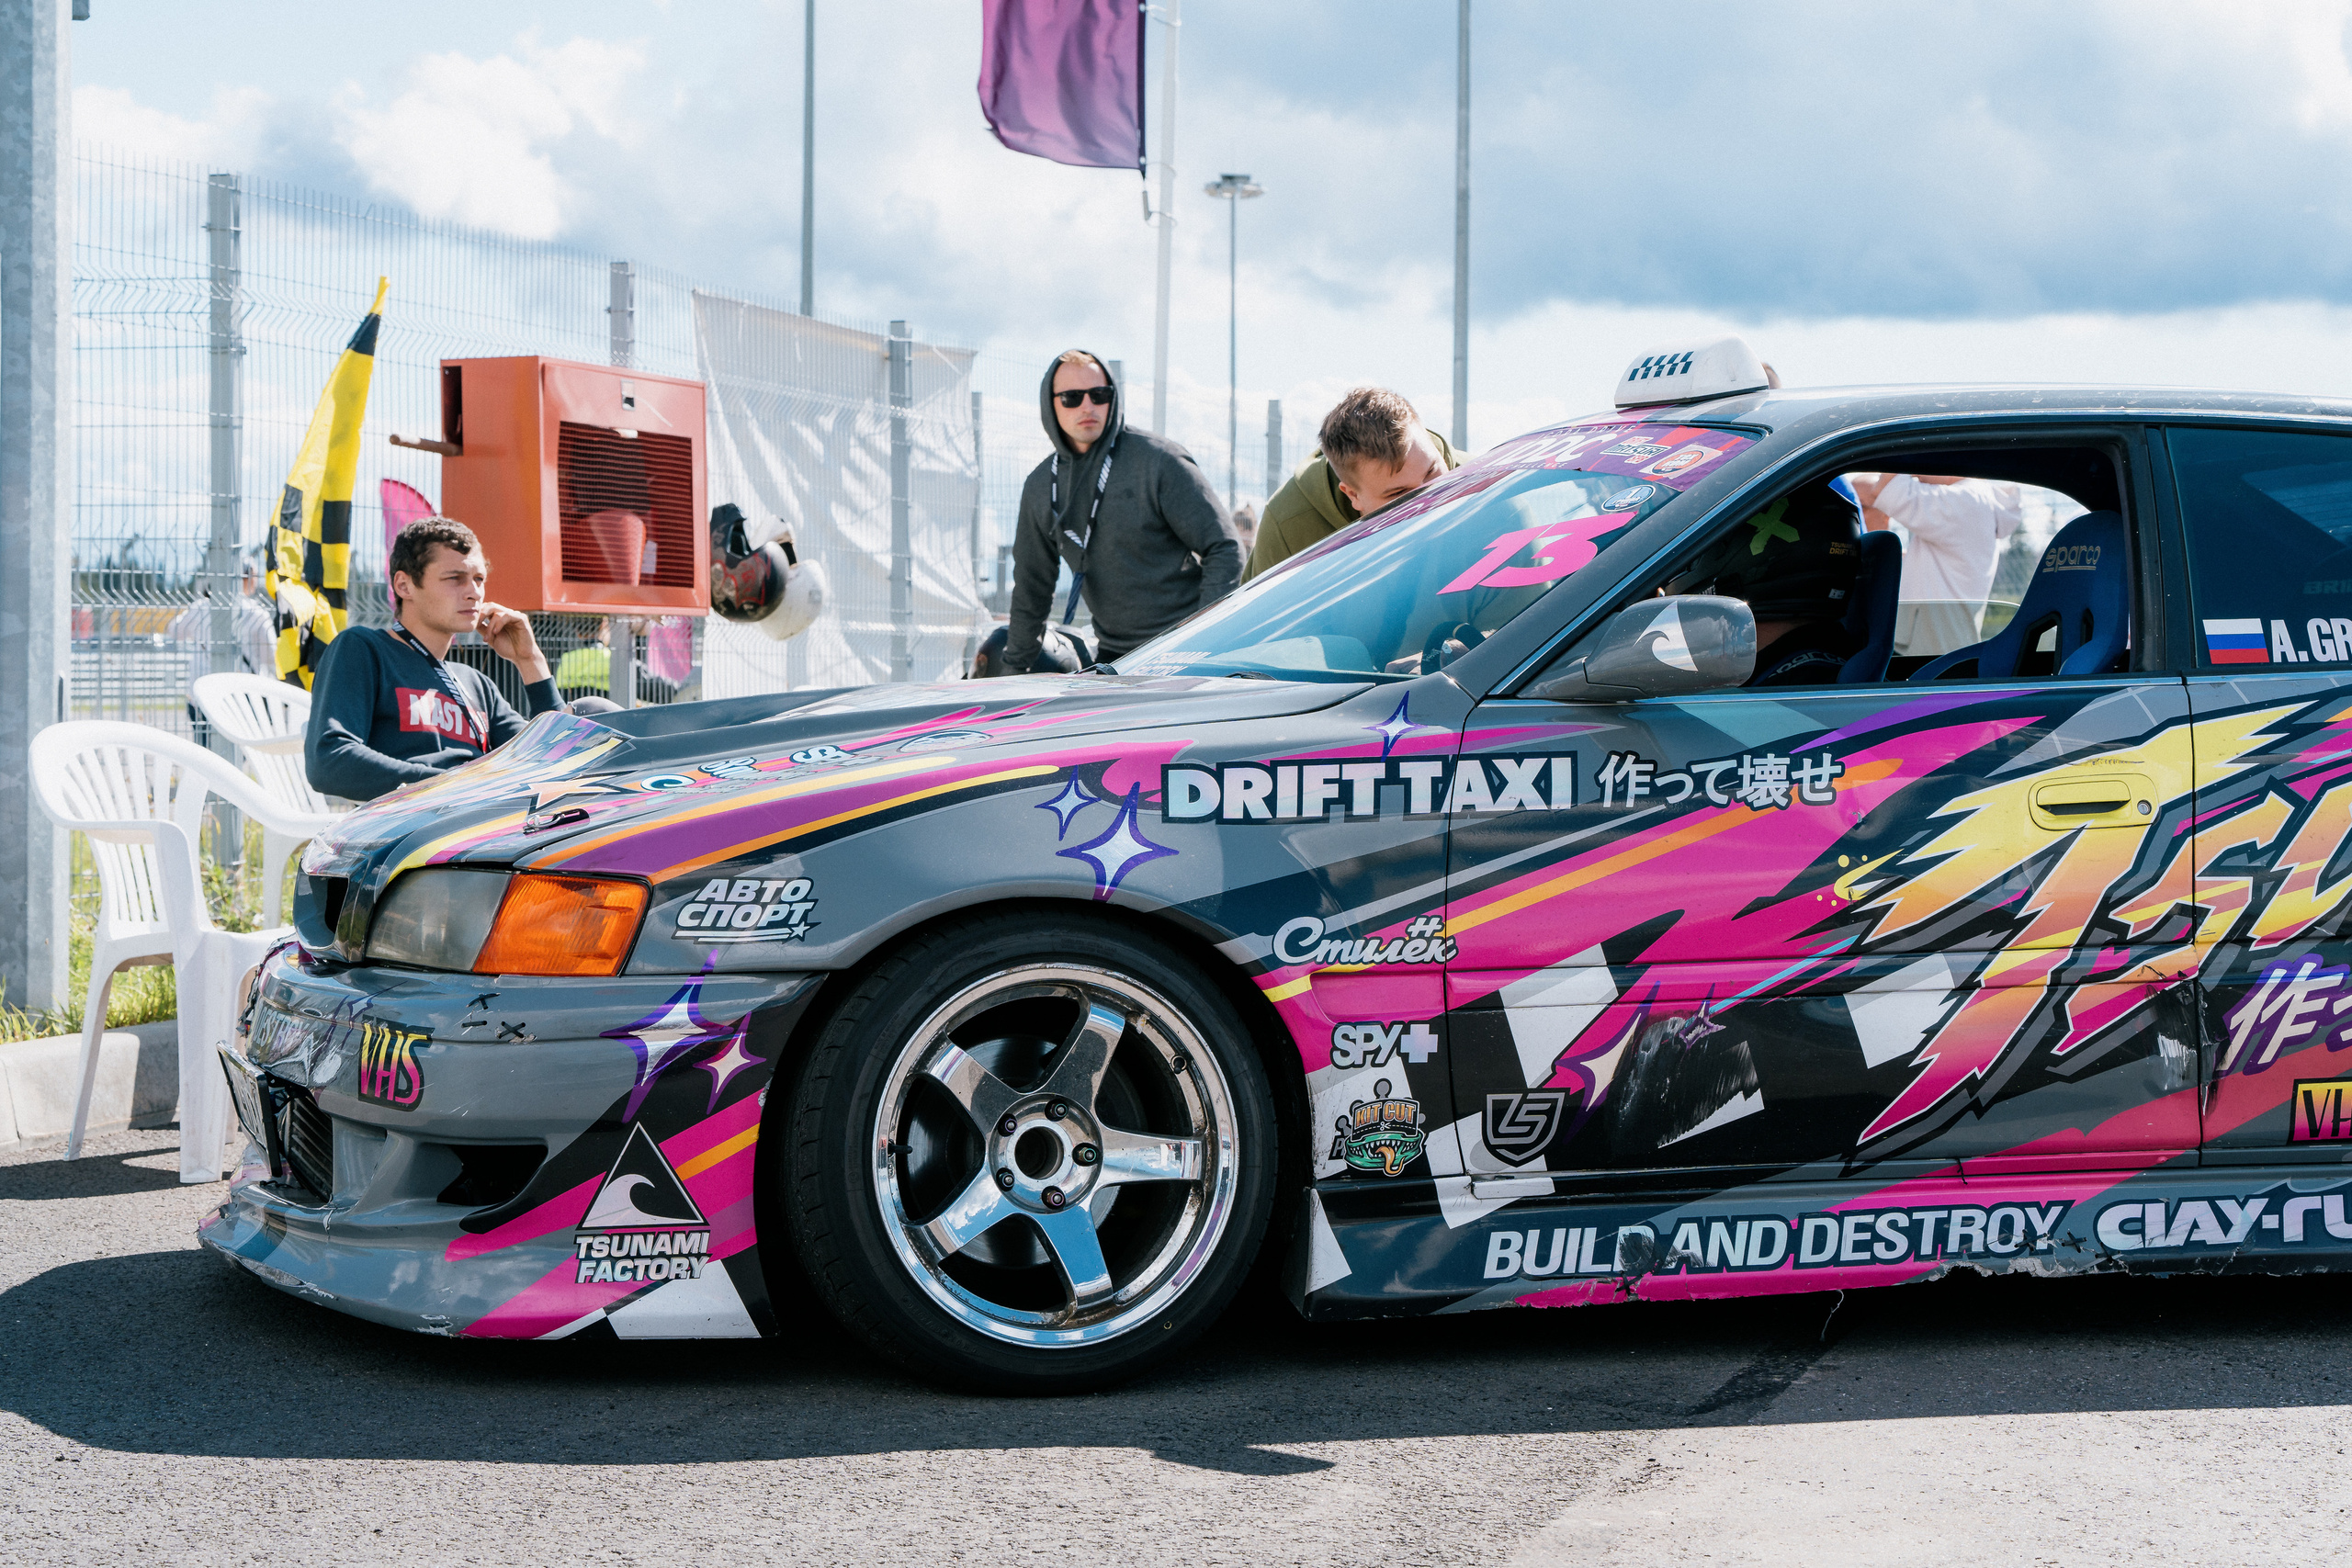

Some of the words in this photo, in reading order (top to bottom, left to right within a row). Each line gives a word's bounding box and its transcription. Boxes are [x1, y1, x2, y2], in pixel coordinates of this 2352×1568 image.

[1436, 512, 1638, 594] 13
[2044, 545, 2101, 572] sparco
[1168, 761, 1385, 818] DRIFT
[1400, 757, 1572, 814] TAXI
[1598, 753, 1842, 808] 作って壊せ
[695, 878, 812, 903] АВТО
[677, 901, 815, 928] СПОРТ
[2215, 963, 2352, 1071] 作
[360, 1022, 427, 1104] VHS
[1355, 1102, 1382, 1129] KIT
[1383, 1101, 1416, 1124] CUT
[576, 1232, 710, 1259] TSUNAMI
[1483, 1226, 1654, 1279] BUILD
[1668, 1220, 1786, 1269] AND
[1799, 1206, 2064, 1264] DESTROY
[578, 1256, 710, 1283] FACTORY
